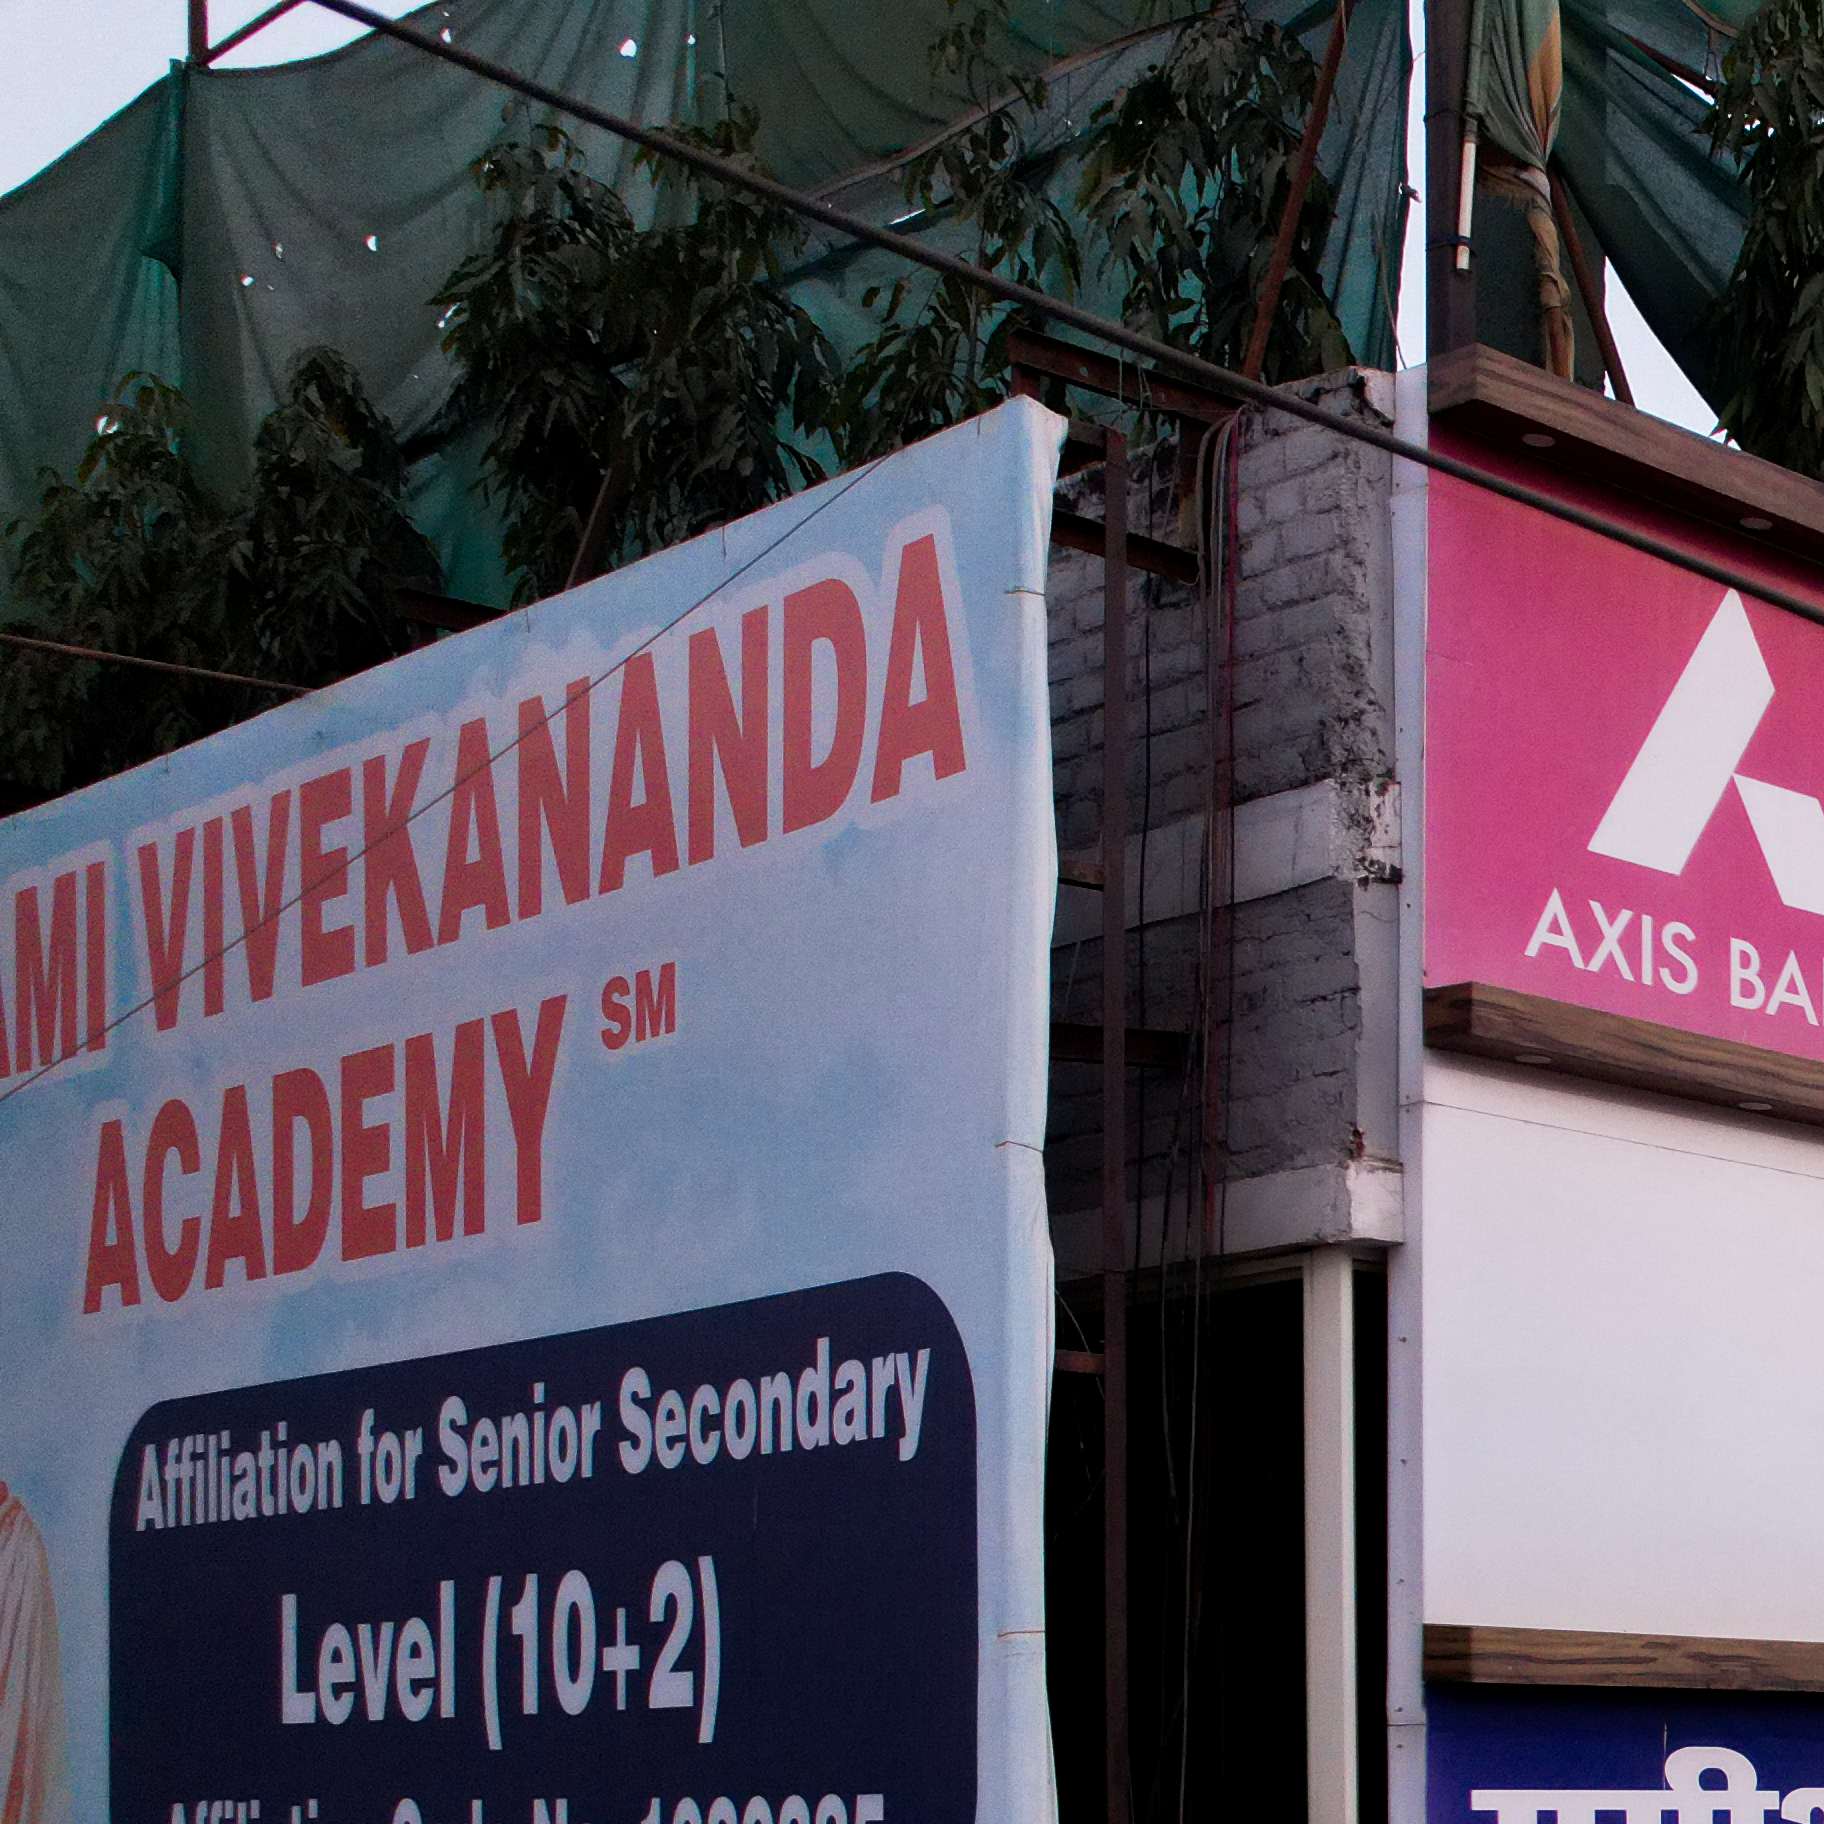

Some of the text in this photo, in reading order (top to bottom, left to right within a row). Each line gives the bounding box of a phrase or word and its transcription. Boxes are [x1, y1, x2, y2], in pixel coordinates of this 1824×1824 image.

[139, 533, 966, 1033] VIVEKANANDA
[1524, 886, 1698, 996] AXIS
[83, 962, 676, 1314] ACADEMY SM
[136, 1337, 930, 1532] Affiliation for Senior Secondary
[281, 1555, 720, 1751] Level (10+2)
